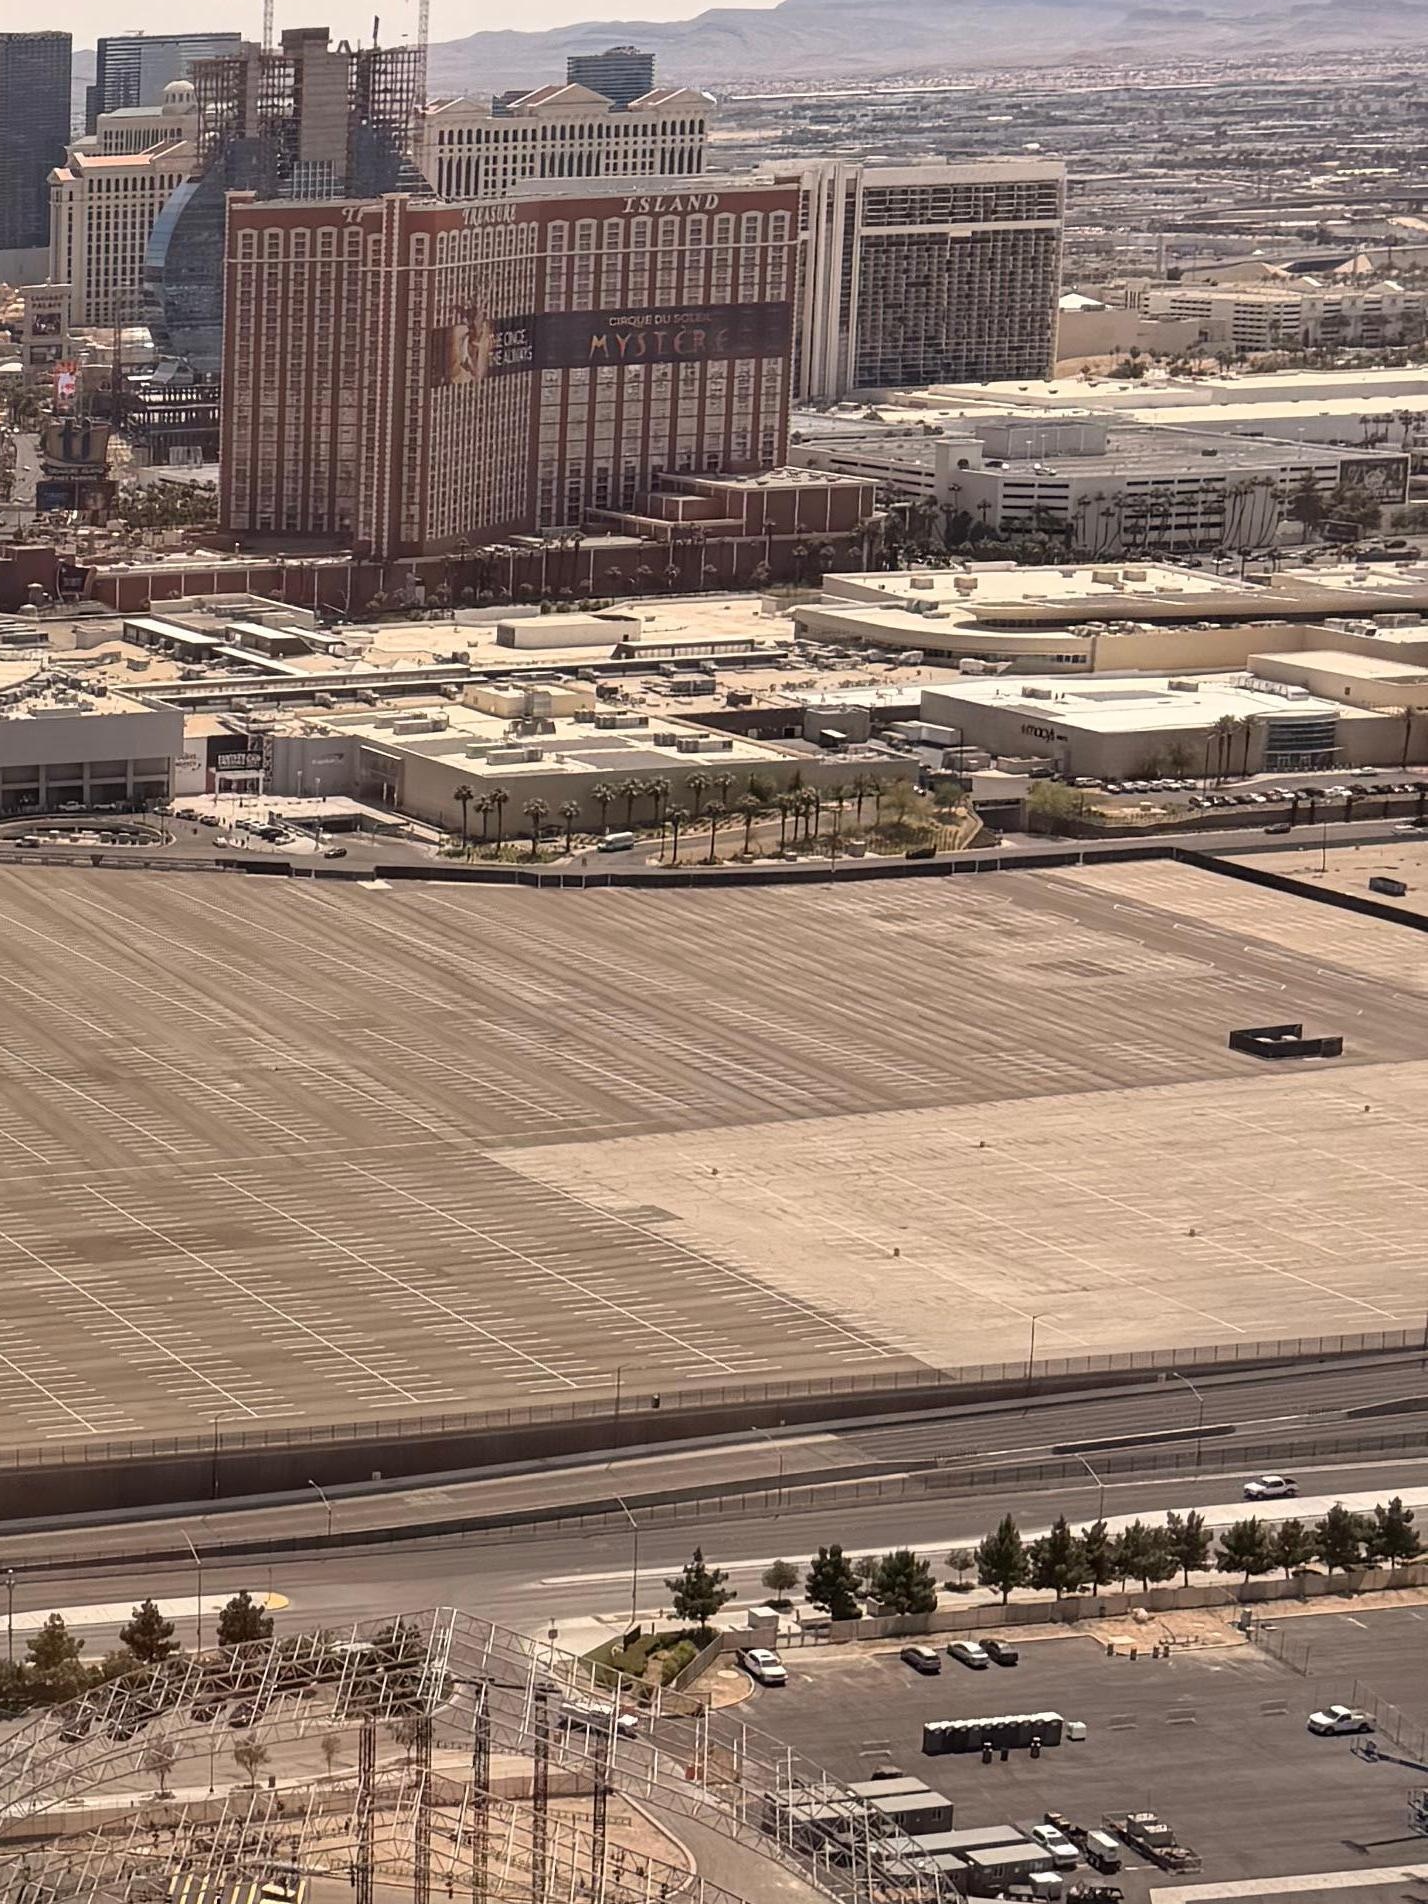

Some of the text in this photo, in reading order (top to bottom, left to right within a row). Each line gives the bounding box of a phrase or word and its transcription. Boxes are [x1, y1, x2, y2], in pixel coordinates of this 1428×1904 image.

[462, 194, 719, 226] TREASURE ISLAND
[609, 315, 653, 329] CIRQUE
[654, 314, 671, 324] DU
